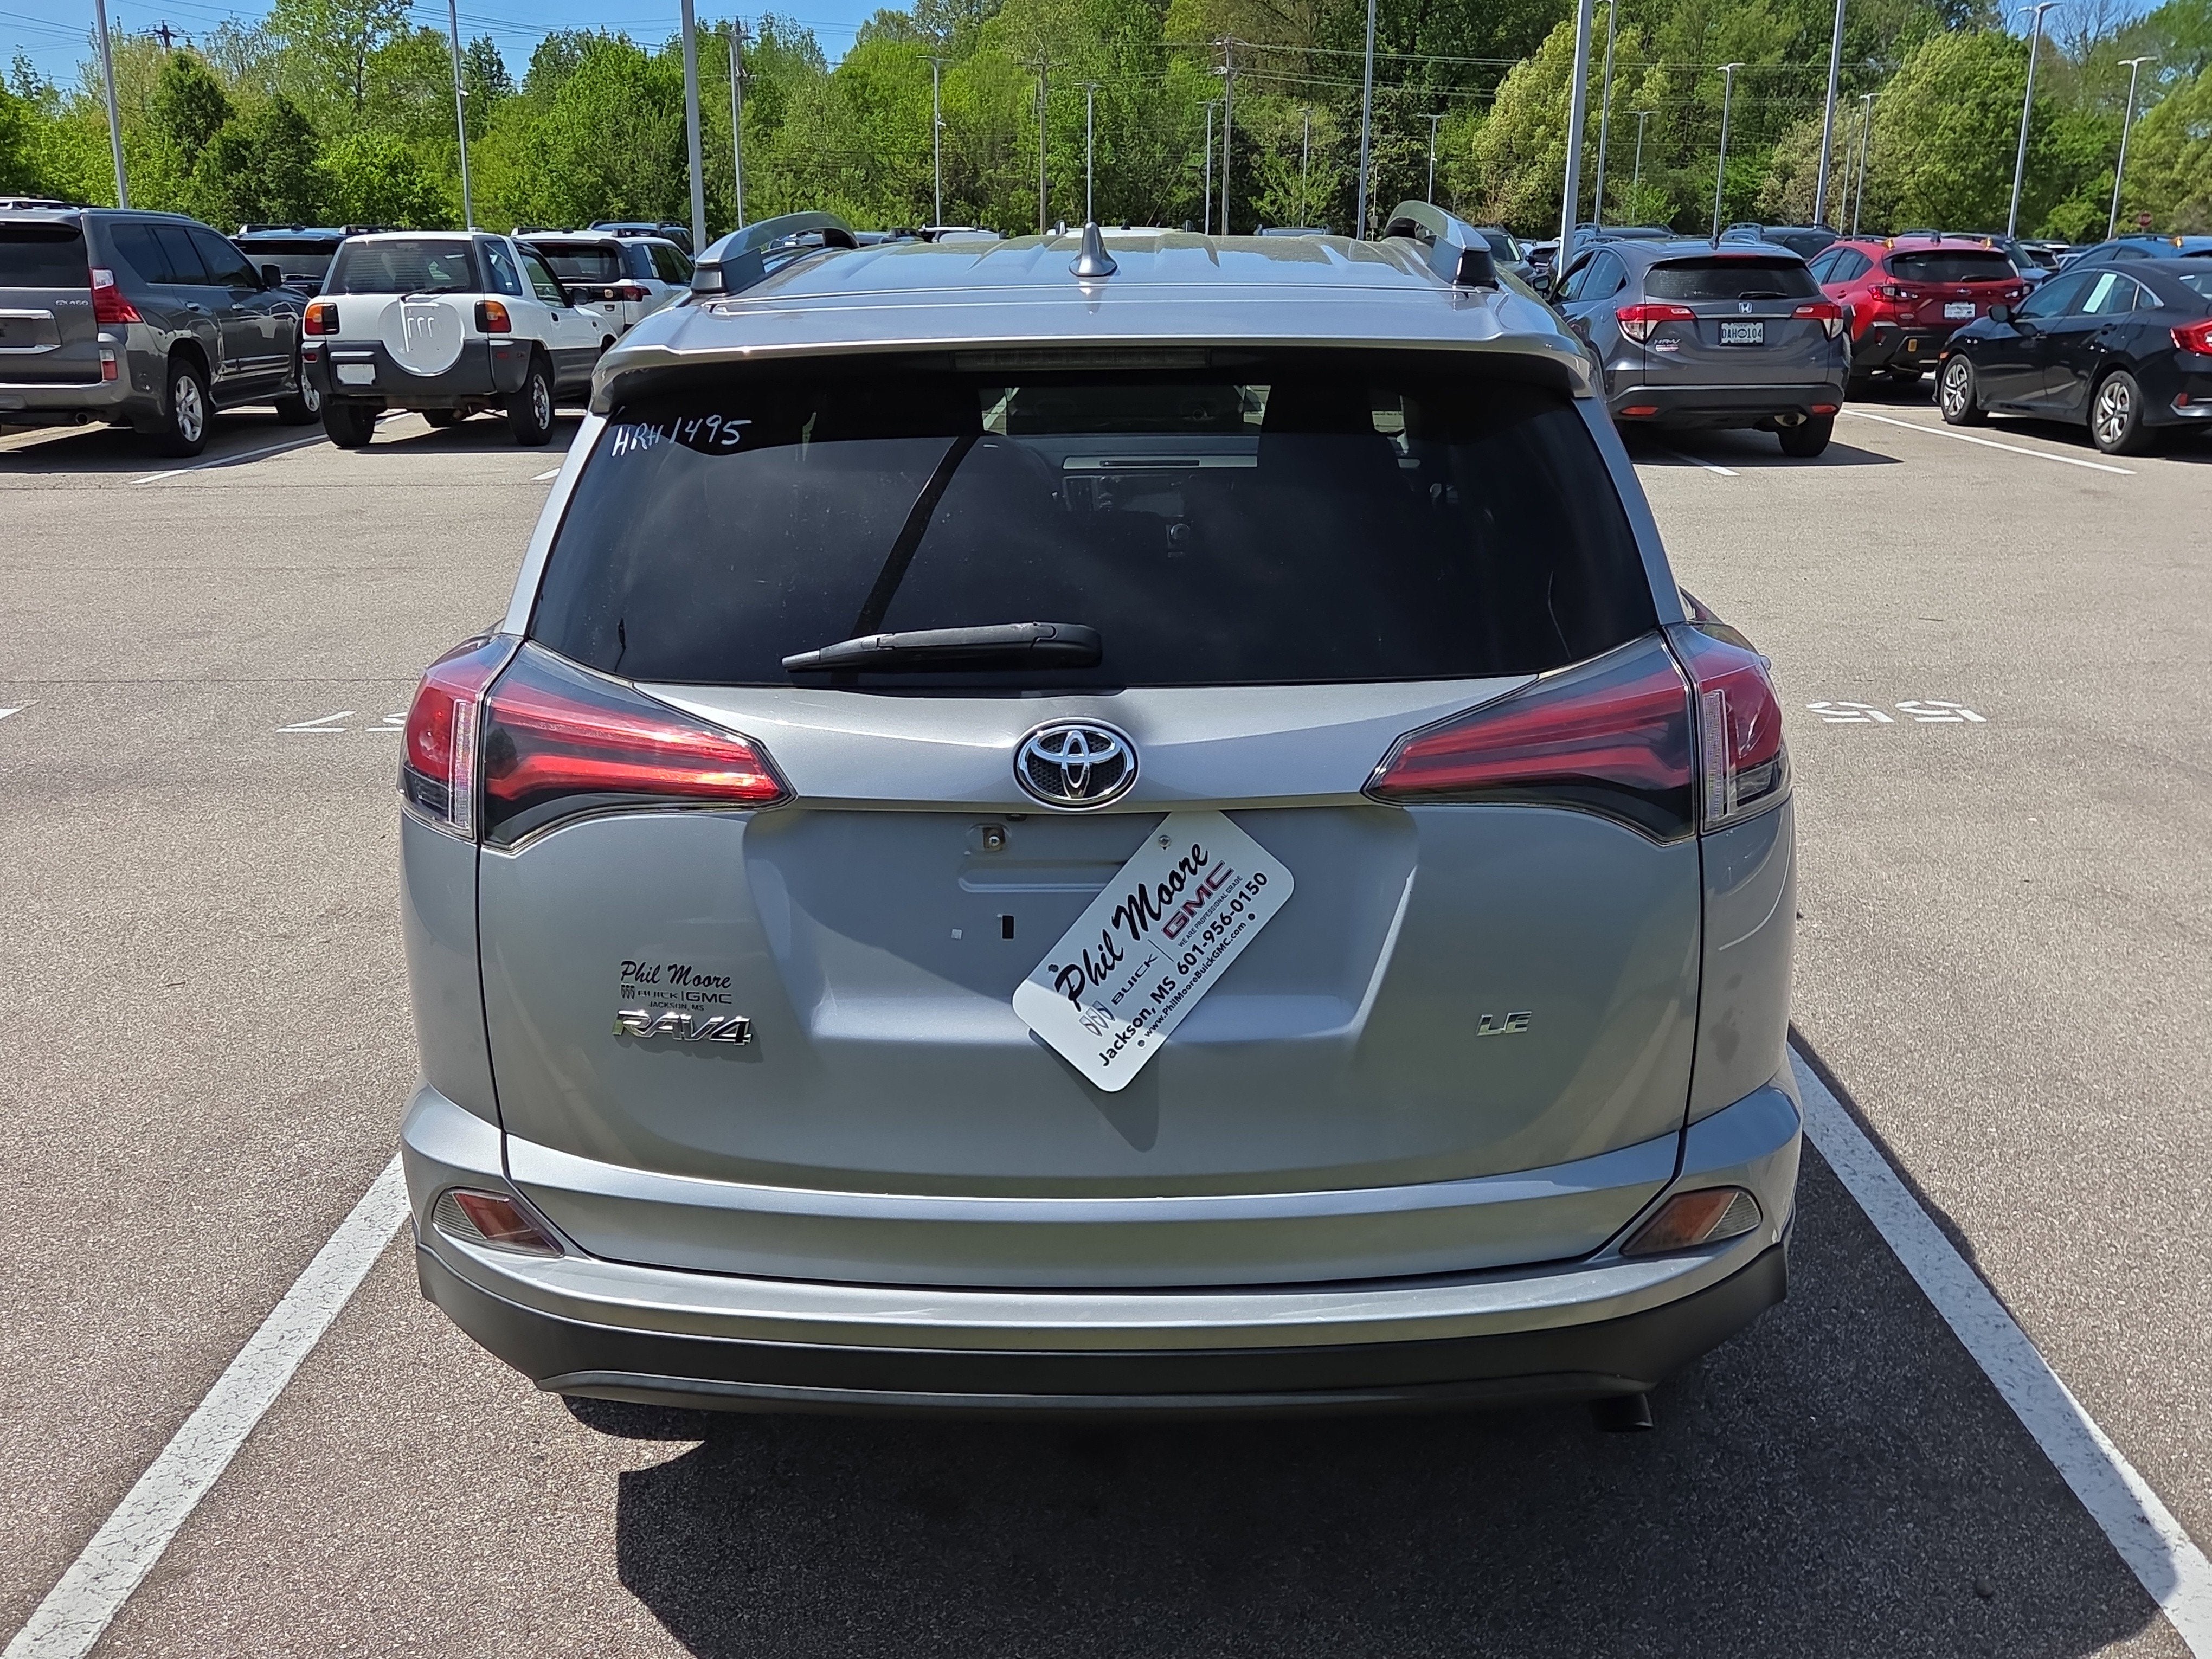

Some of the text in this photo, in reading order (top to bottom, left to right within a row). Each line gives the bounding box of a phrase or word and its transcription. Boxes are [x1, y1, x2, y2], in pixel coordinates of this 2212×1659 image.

[1055, 843, 1208, 1012] Phil Moore
[1111, 860, 1234, 1006] BUICK GMC
[1178, 875, 1243, 948] WE ARE PROFESSIONAL GRADE
[621, 961, 732, 988] Phil Moore
[686, 992, 732, 1004] GMC
[1098, 872, 1268, 1067] Jackson, MS 601-956-0150
[1144, 922, 1247, 1037] www.PhilMooreBuickGMC.com
[612, 1009, 753, 1046] RAV4
[1476, 1009, 1532, 1036] LE
